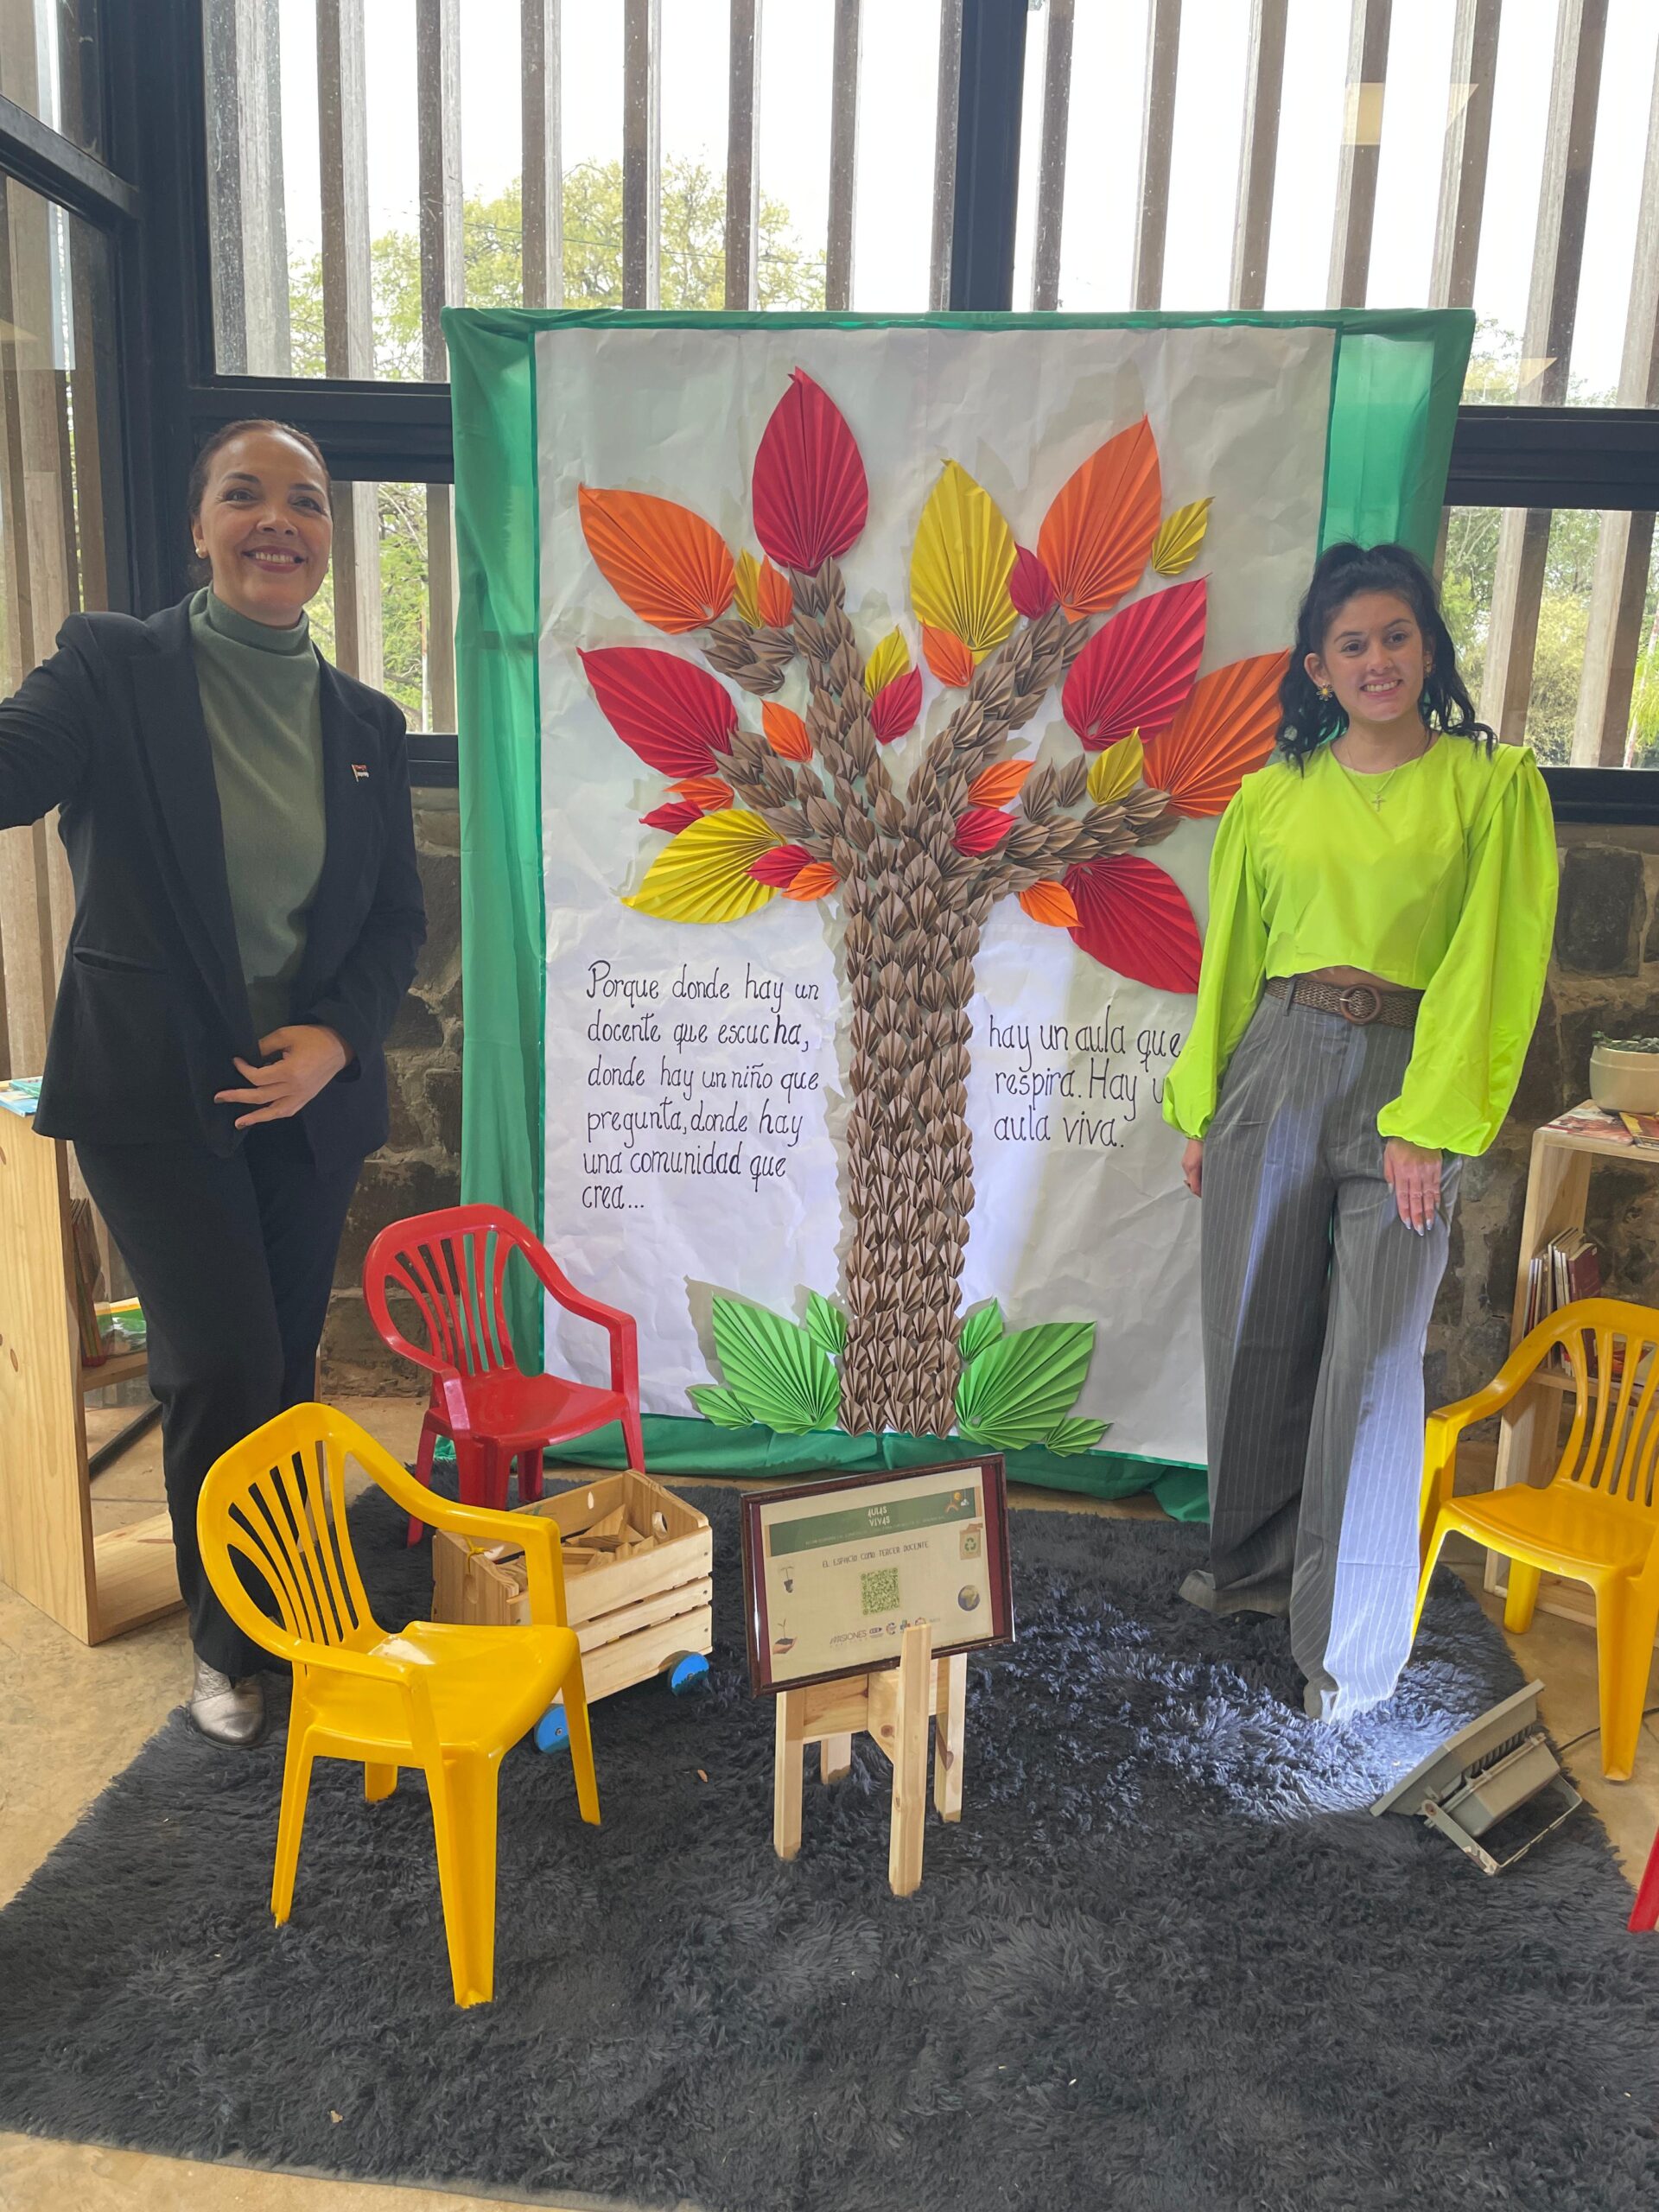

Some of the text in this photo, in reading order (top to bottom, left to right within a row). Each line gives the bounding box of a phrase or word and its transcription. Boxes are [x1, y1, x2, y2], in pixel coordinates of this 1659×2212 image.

[587, 960, 819, 1014] Porque donde hay un
[588, 1009, 809, 1054] docente que escucha,
[989, 1005, 1181, 1072] hay un aula que
[588, 1054, 645, 1086] donde
[660, 1055, 694, 1101] hay
[780, 1071, 819, 1103] que
[995, 1068, 1082, 1111] respira.
[1089, 1057, 1137, 1122] Hay
[690, 1100, 748, 1133] donde
[759, 1098, 803, 1147] hay
[994, 1104, 1124, 1148] aula viva.
[583, 1141, 786, 1192] una comunidad que
[582, 1184, 645, 1209] crea...
[868, 1506, 887, 1518] AULAS
[869, 1516, 891, 1527] VIVAS
[822, 1560, 830, 1568] EL
[879, 1546, 900, 1557] TERCER
[903, 1541, 929, 1553] DOCENTE
